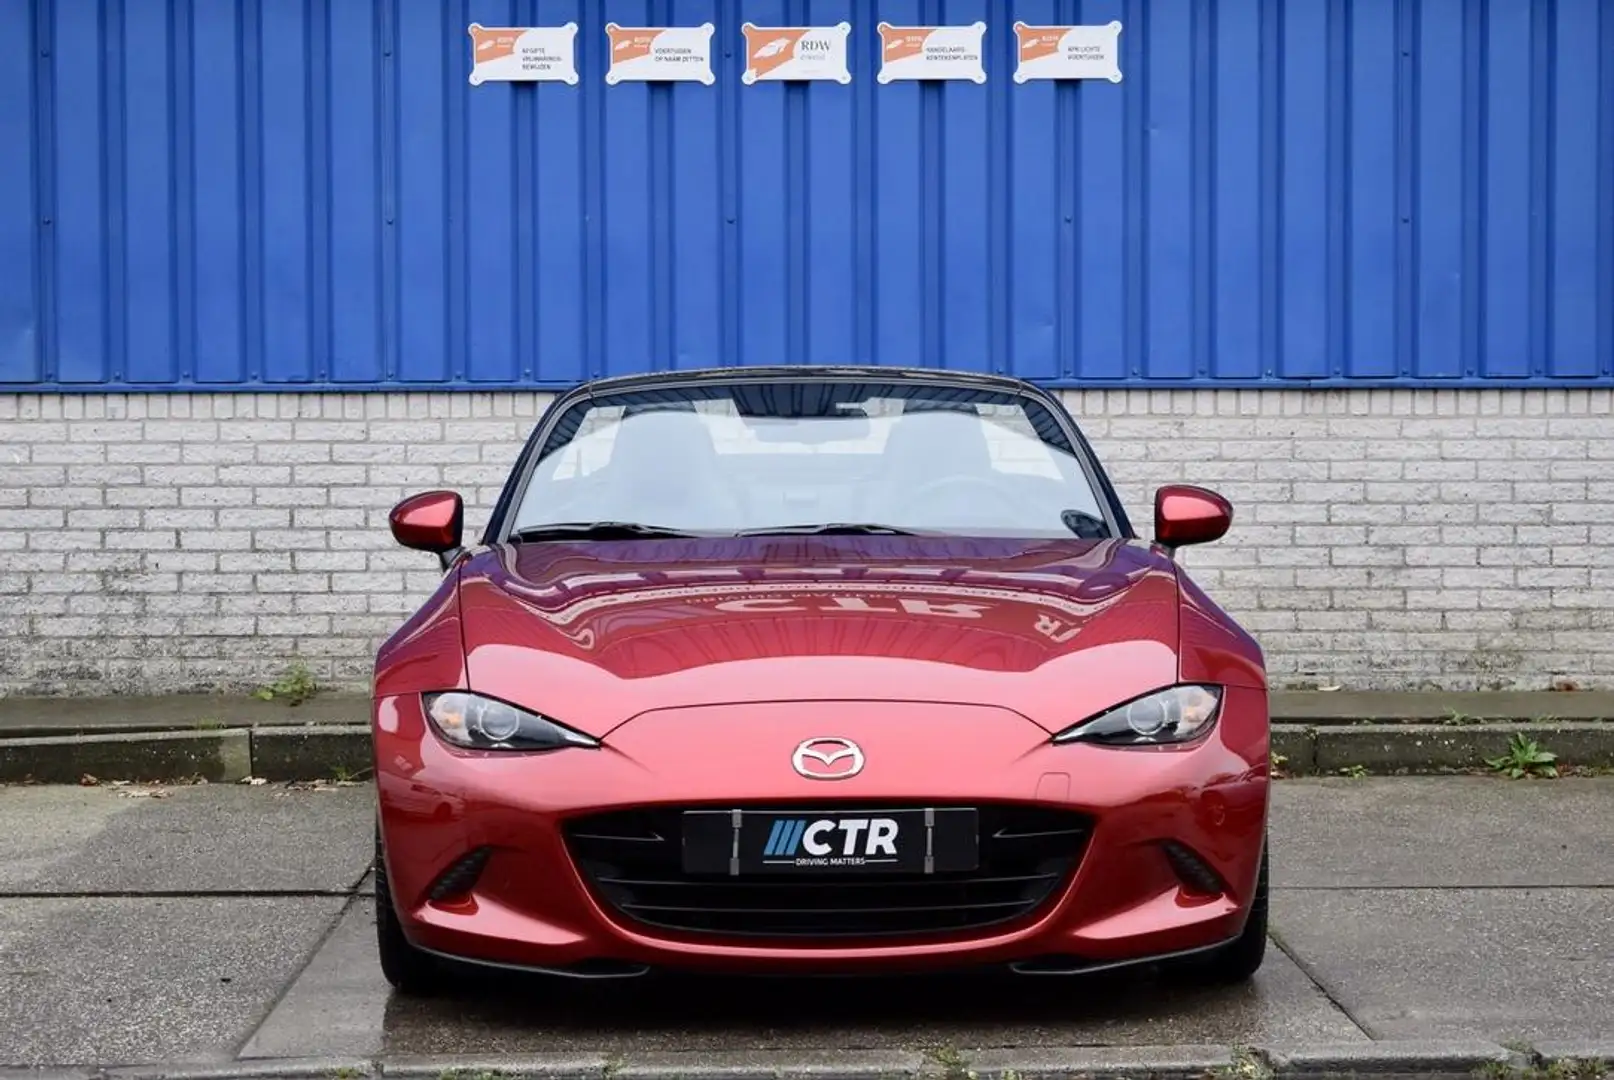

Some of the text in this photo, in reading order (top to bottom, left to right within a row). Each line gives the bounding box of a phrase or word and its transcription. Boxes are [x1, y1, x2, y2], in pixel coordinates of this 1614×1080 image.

[800, 40, 830, 51] RDW
[802, 818, 899, 856] CTR
[795, 857, 865, 867] DRIVING MATTERS
